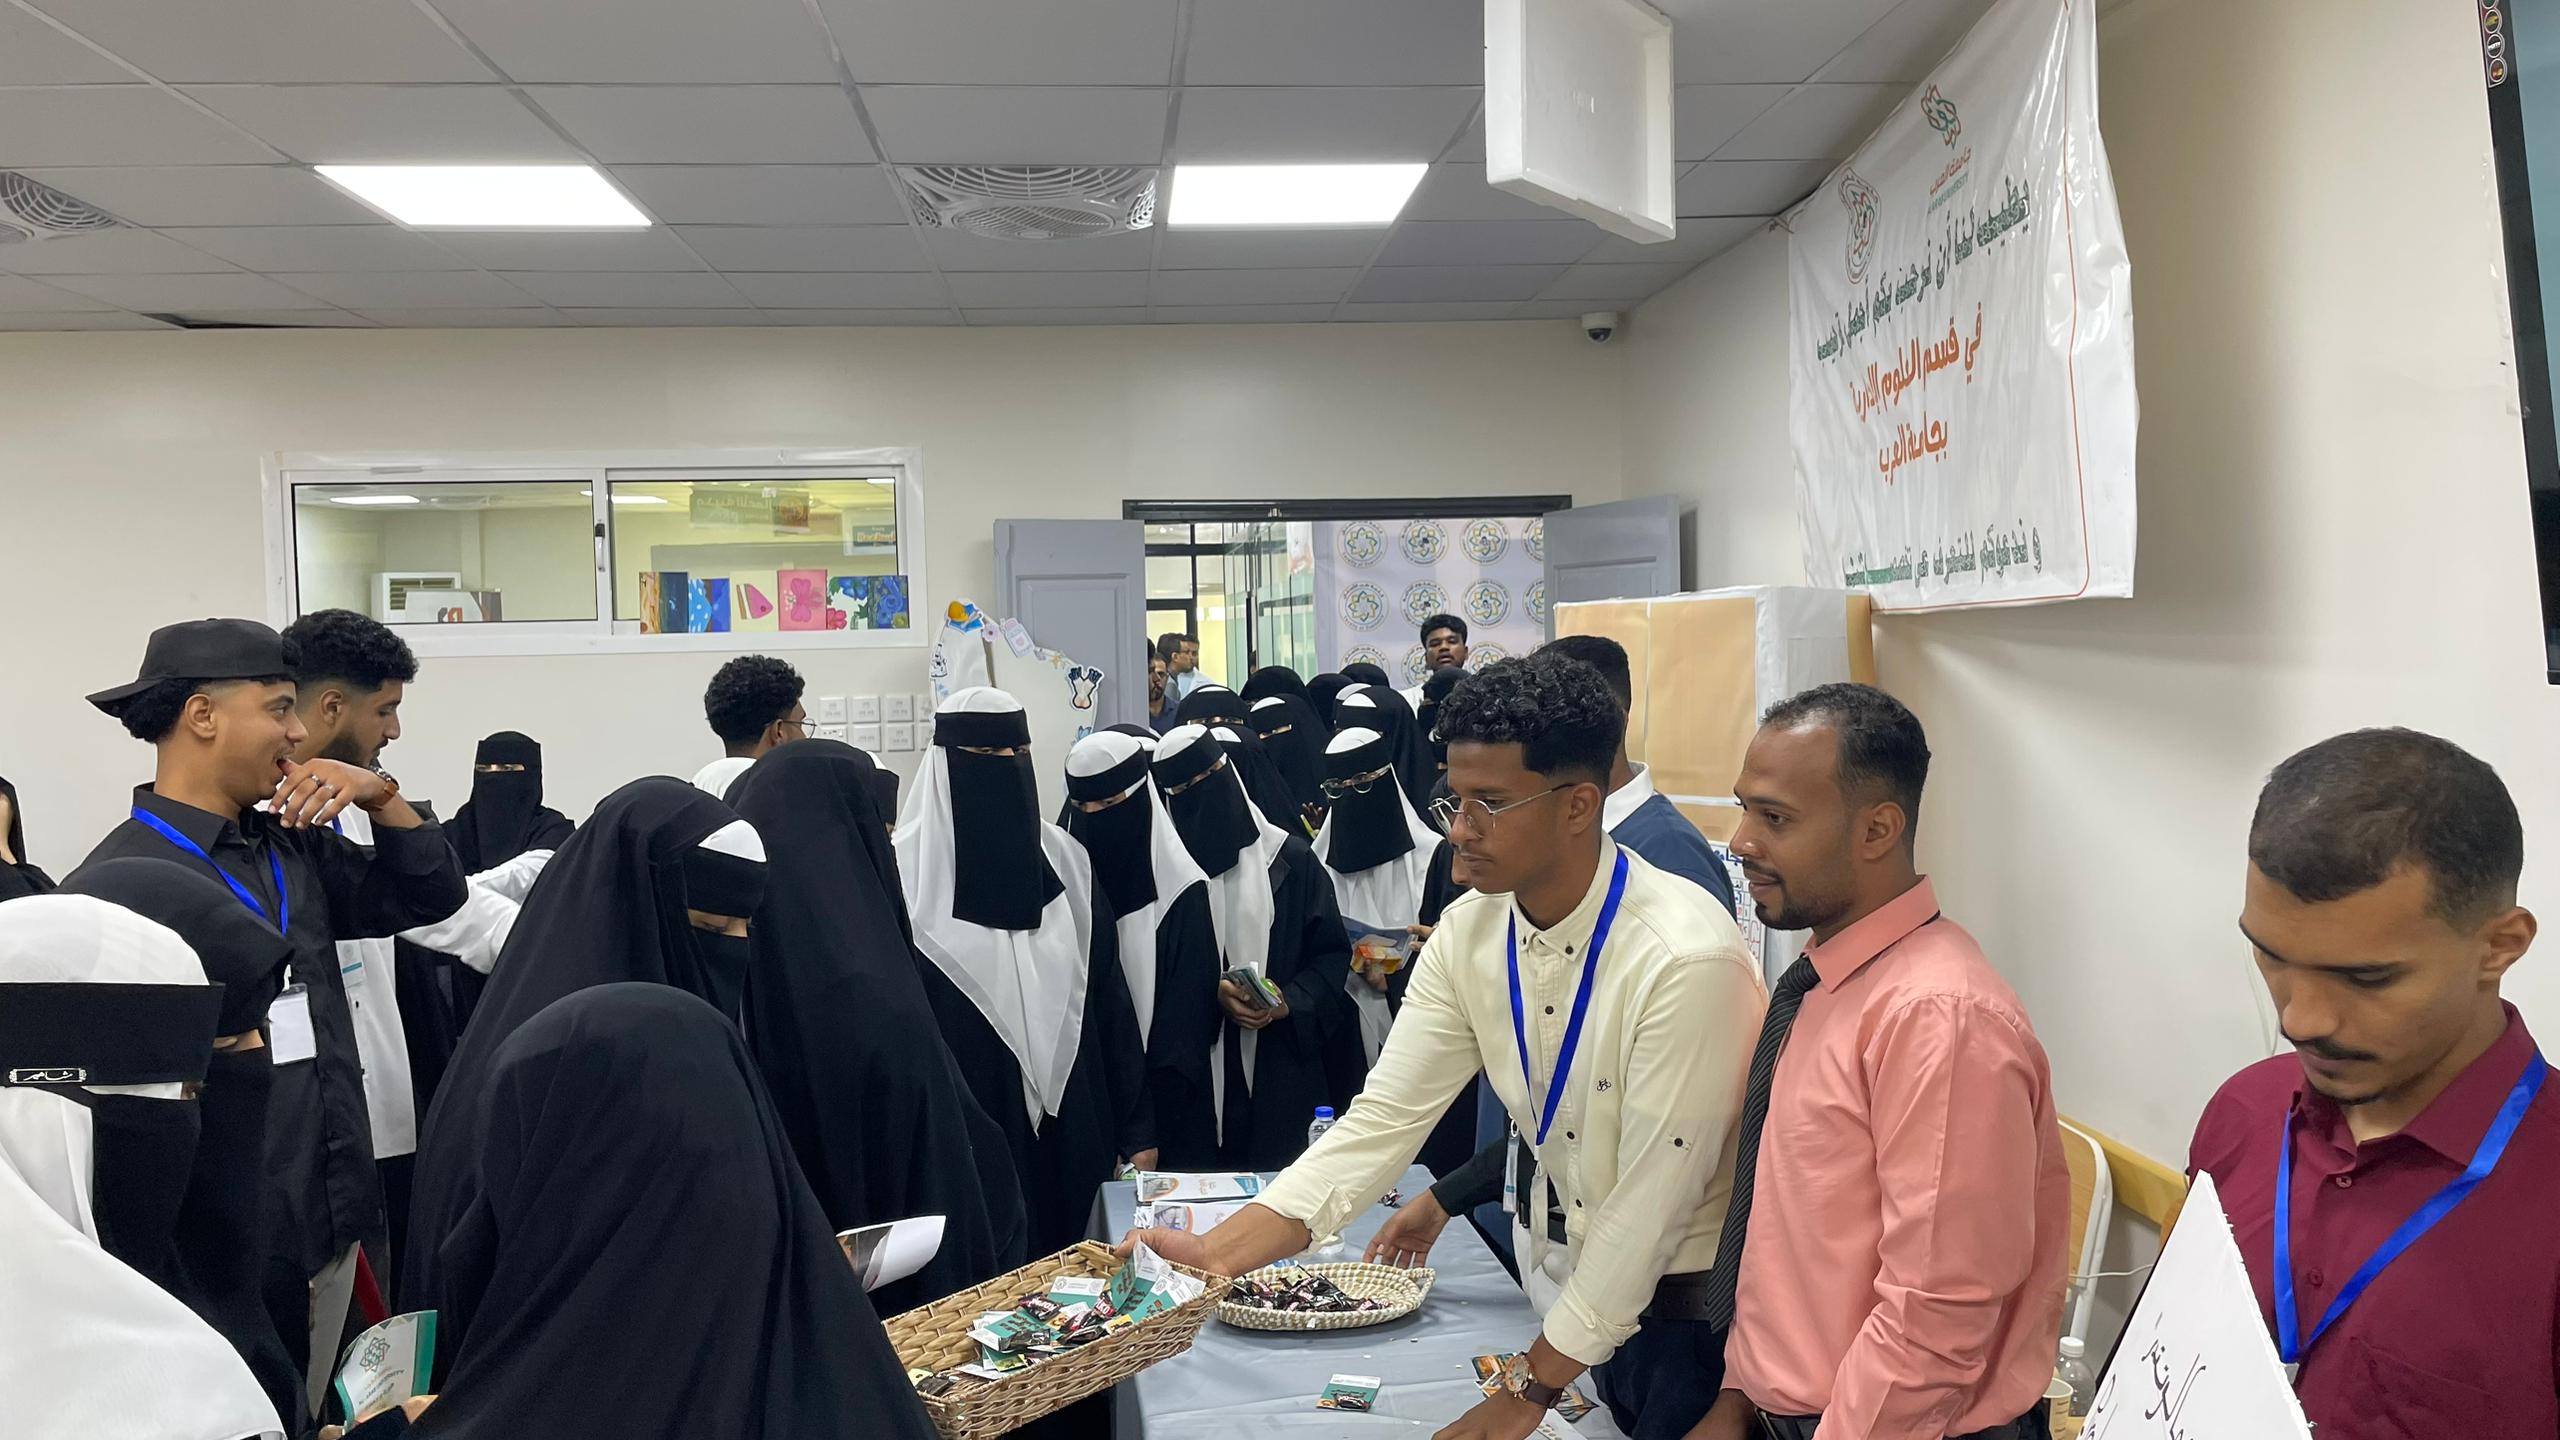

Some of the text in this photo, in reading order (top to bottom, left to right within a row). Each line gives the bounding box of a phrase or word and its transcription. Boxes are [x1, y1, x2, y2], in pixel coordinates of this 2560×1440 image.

[1881, 336, 1921, 412] العلوم
[1923, 315, 1960, 392] قسم
[1964, 301, 1983, 385] في
[1879, 410, 1949, 487] بجامعة العرب
